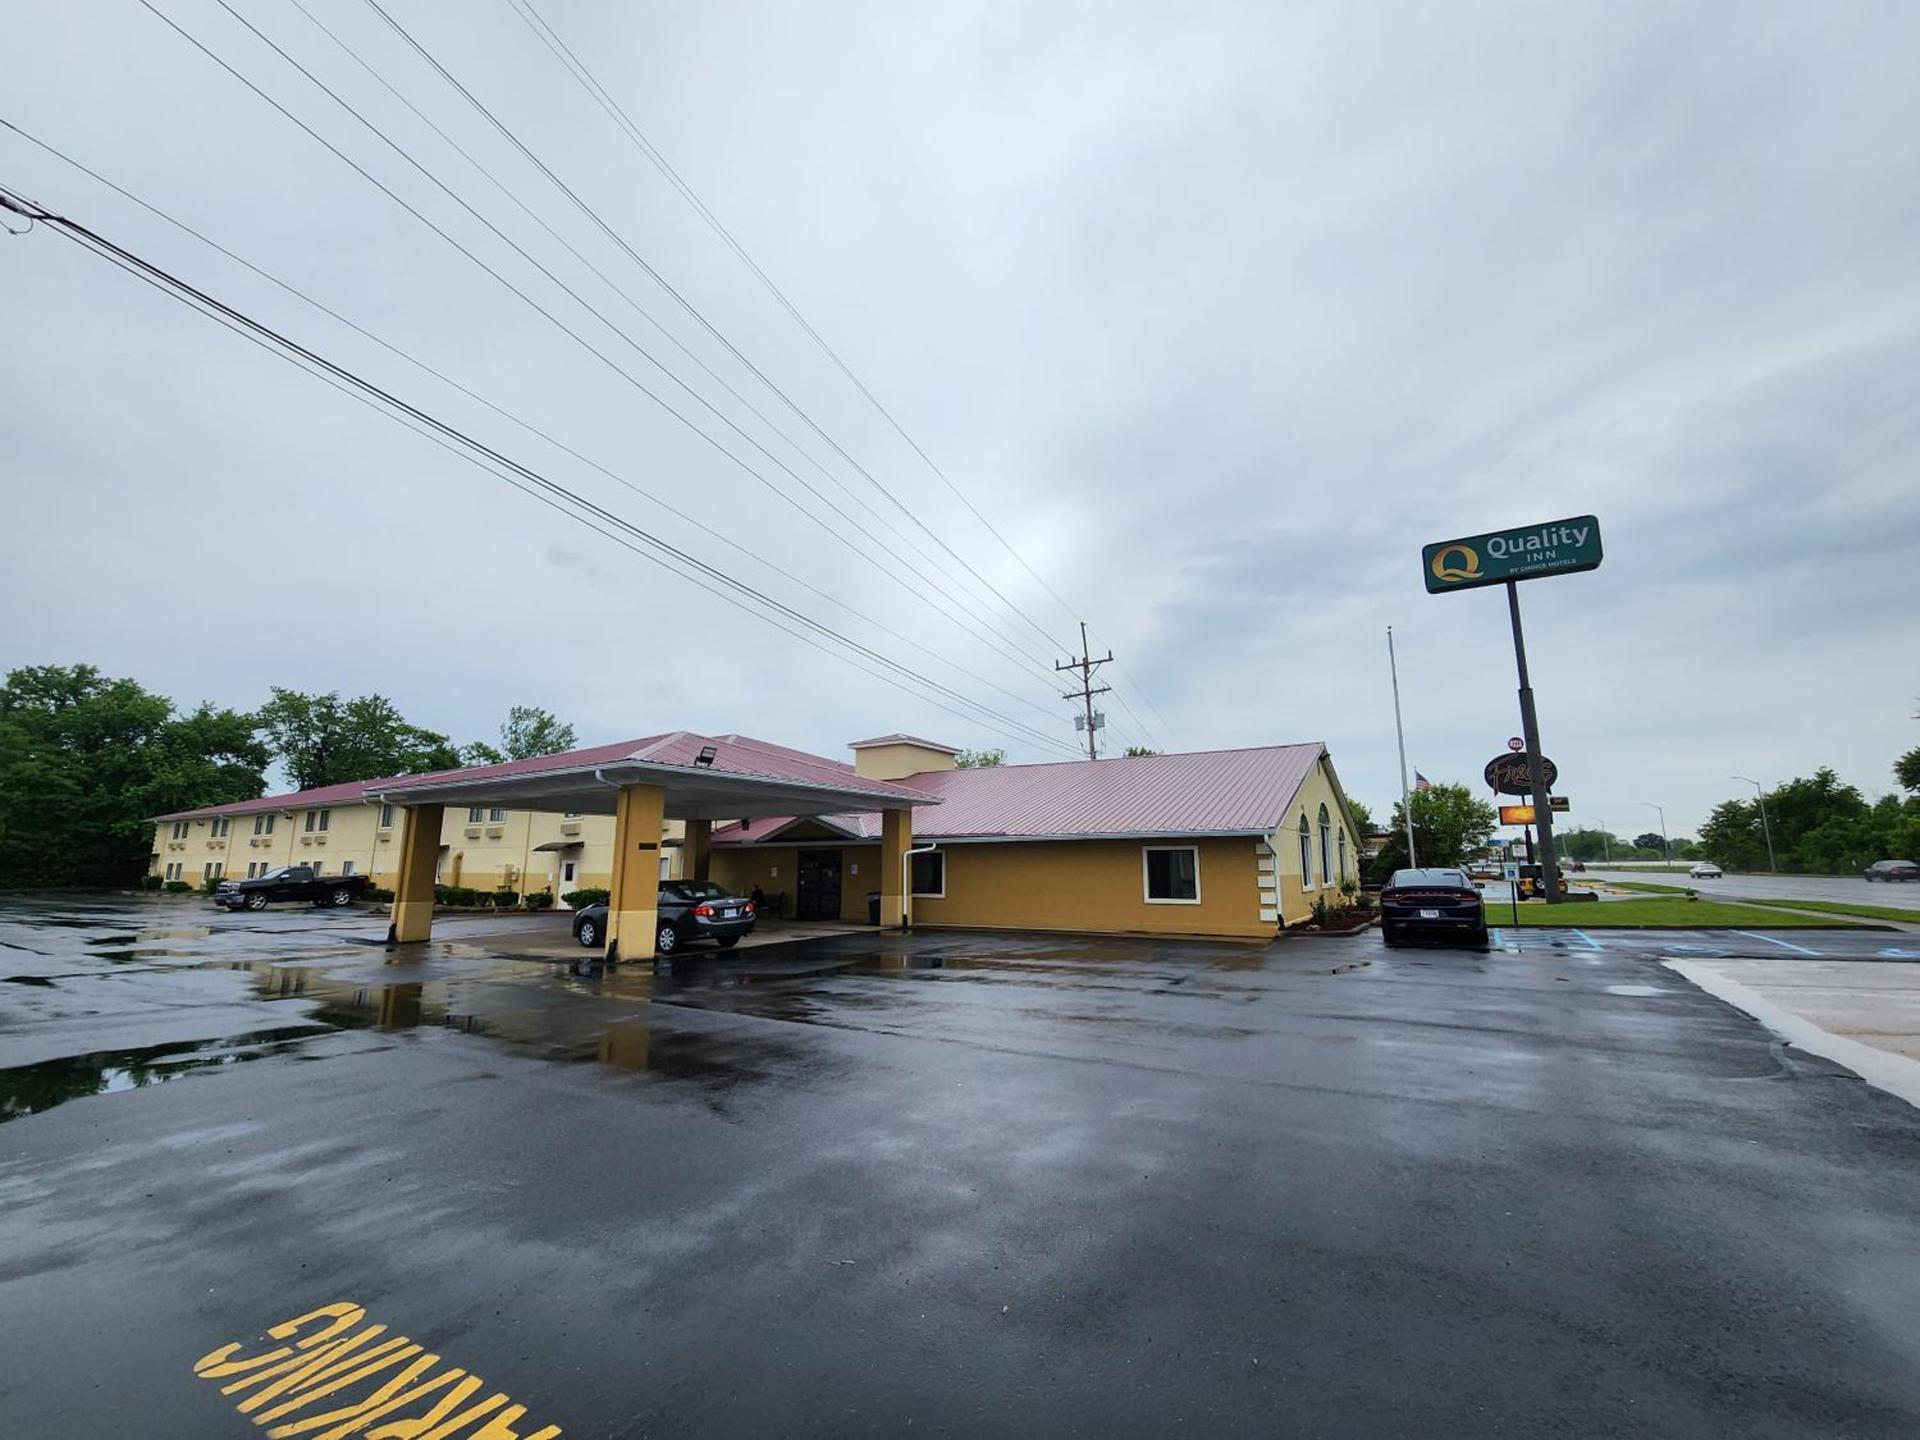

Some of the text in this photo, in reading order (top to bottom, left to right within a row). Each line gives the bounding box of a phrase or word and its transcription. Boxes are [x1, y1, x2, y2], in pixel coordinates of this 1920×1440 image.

[1487, 526, 1589, 559] Quality
[1431, 544, 1484, 582] Q
[1520, 563, 1547, 572] CHOICE
[1548, 558, 1577, 567] HOTELS
[1526, 549, 1557, 563] INN
